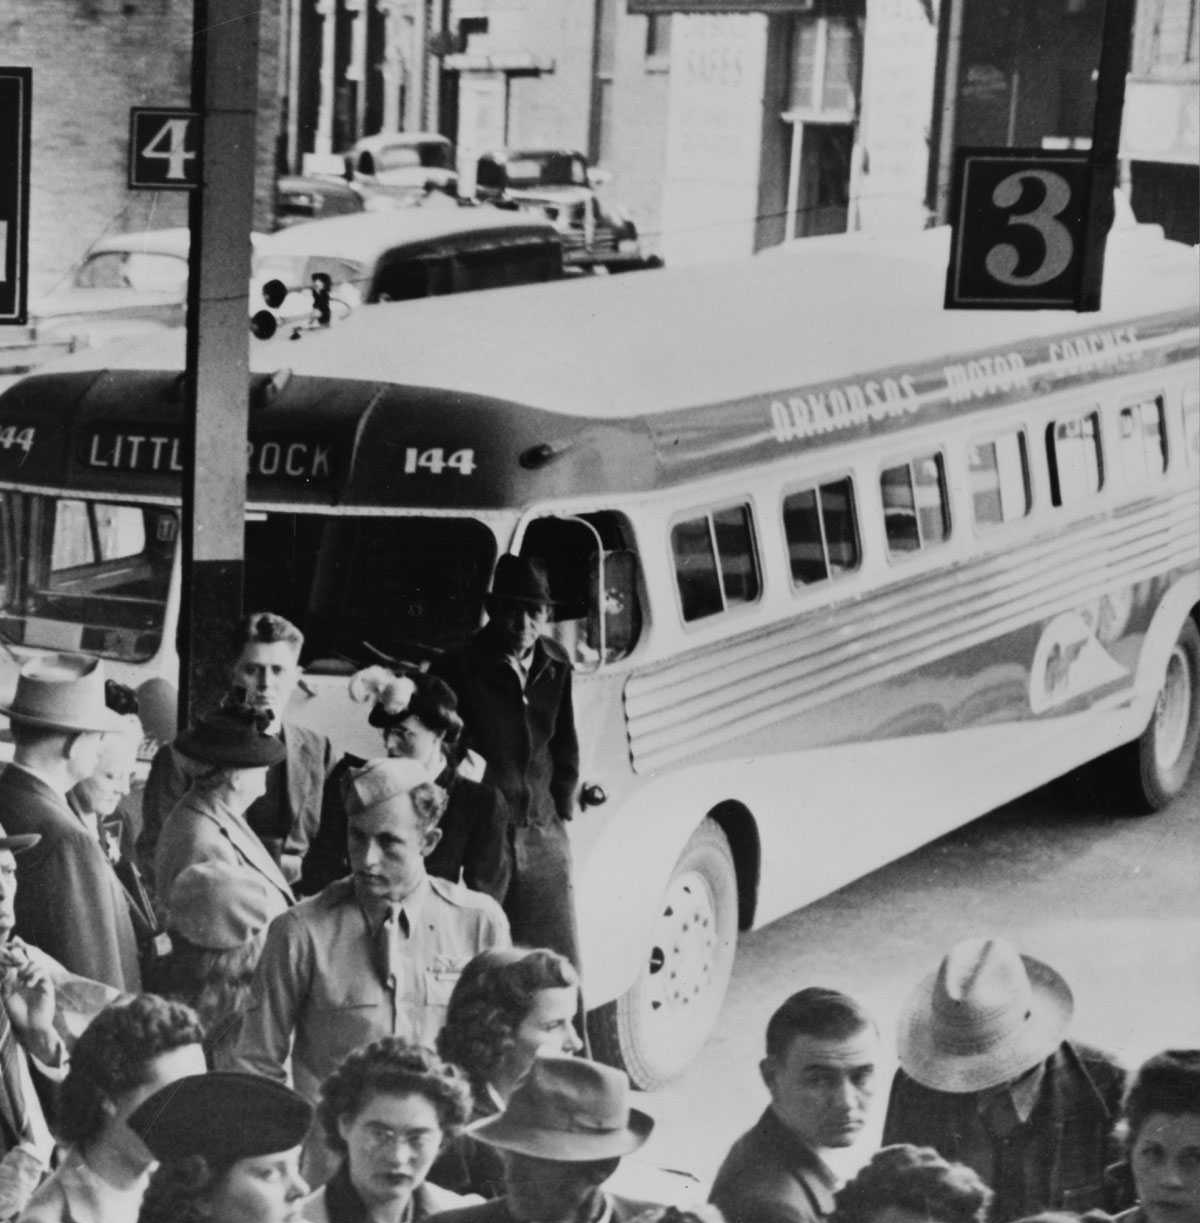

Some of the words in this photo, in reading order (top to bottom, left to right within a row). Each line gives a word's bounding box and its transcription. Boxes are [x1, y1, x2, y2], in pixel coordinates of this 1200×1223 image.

[141, 119, 196, 179] 4
[985, 169, 1074, 286] 3
[89, 434, 184, 470] LITTL
[247, 441, 329, 477] OCK
[404, 447, 478, 475] 144
